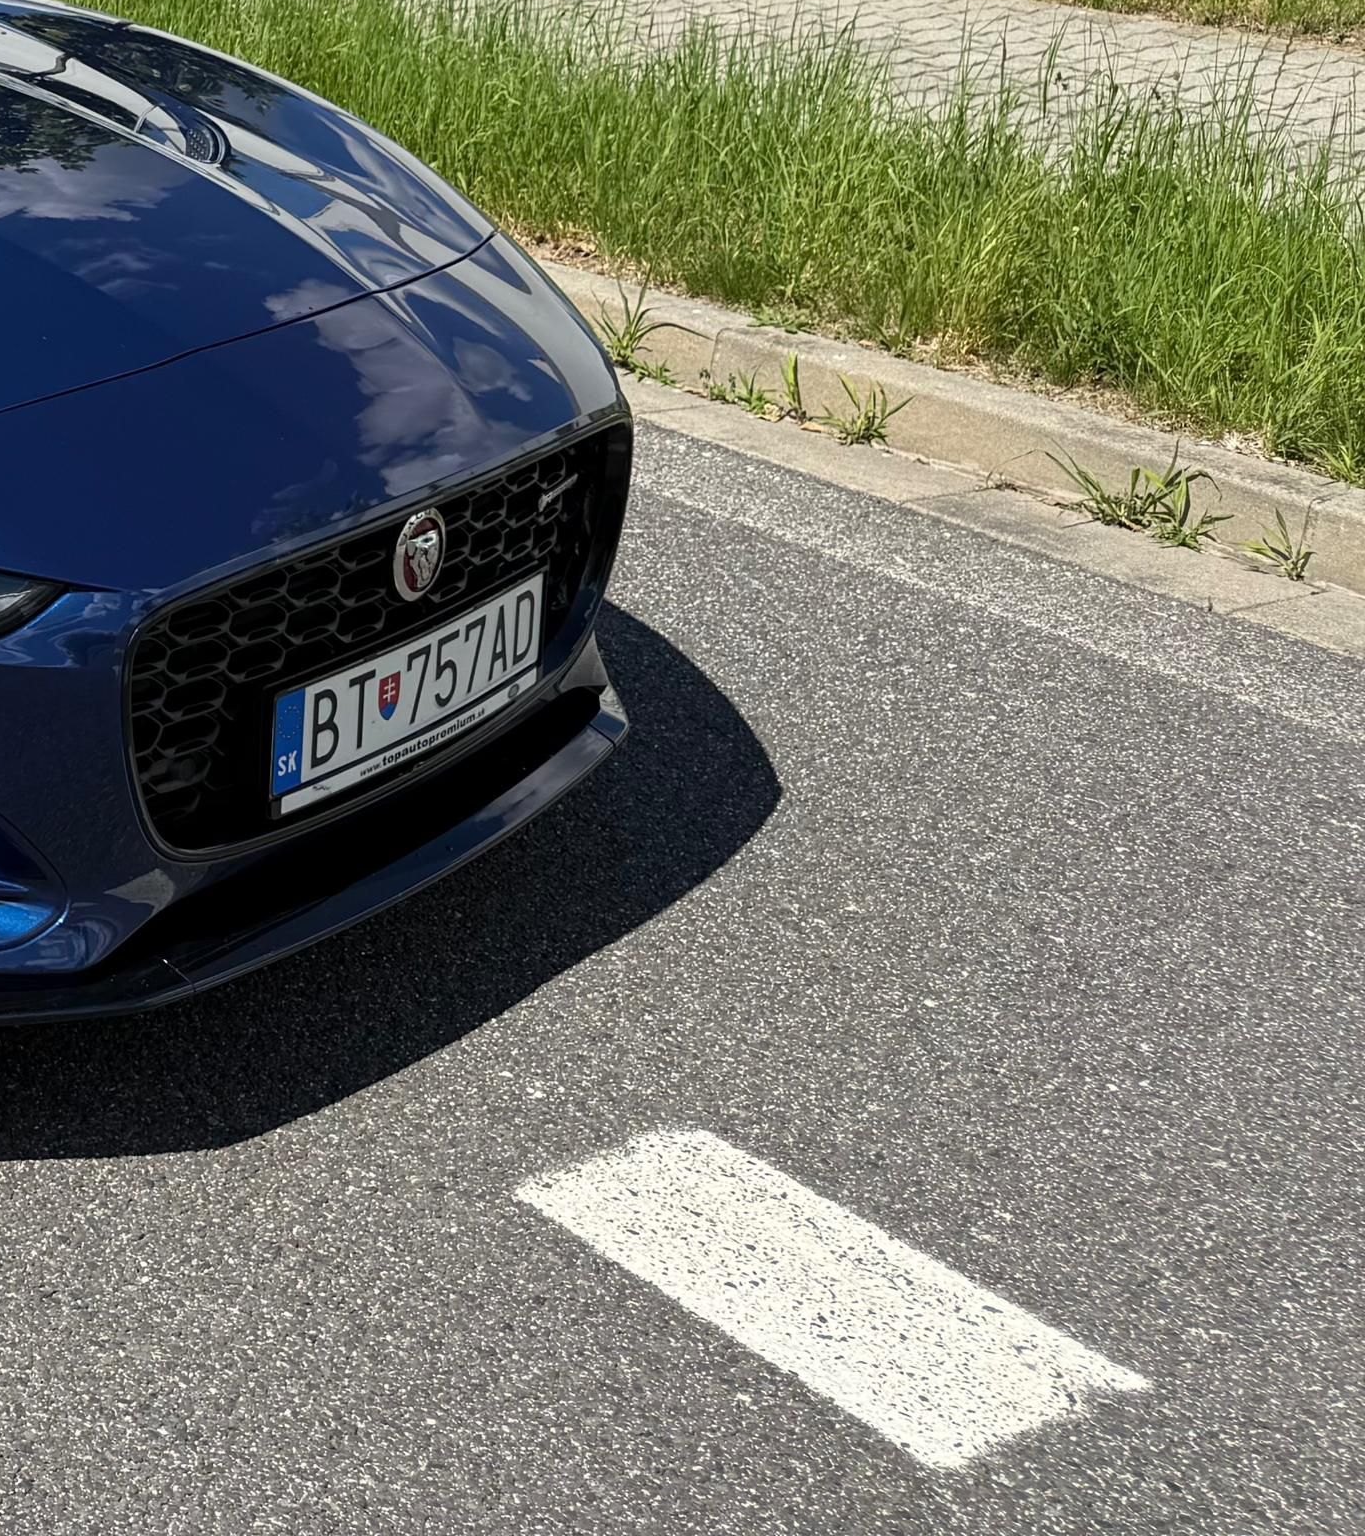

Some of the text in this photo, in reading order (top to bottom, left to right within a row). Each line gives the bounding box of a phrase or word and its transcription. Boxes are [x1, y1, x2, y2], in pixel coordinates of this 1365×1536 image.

[311, 590, 535, 769] BT 757AD
[277, 750, 298, 777] SK
